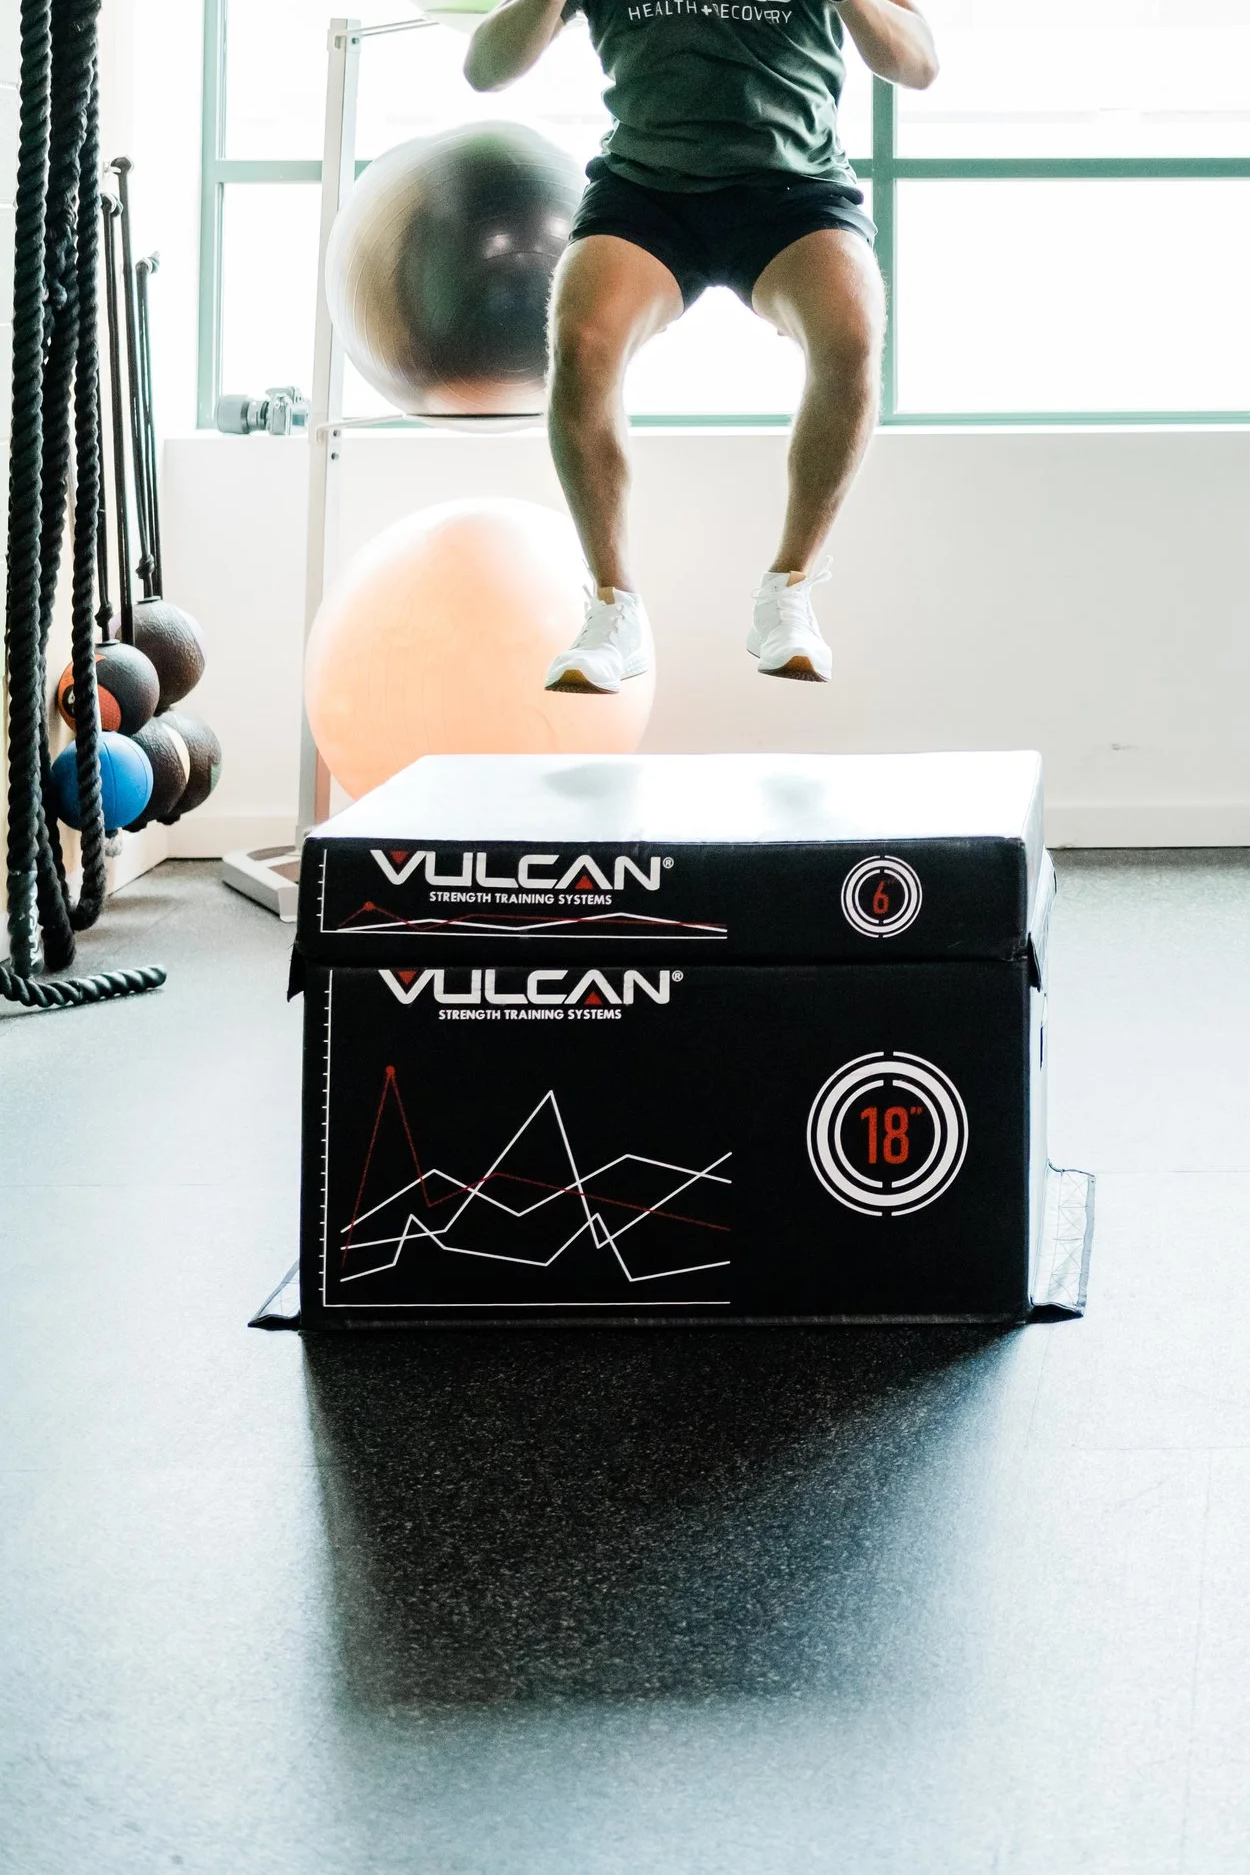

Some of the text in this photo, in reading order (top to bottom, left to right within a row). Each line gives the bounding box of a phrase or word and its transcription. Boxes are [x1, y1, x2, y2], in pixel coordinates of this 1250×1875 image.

[429, 891, 612, 906] STRENGTH TRAINING SYSTEMS
[438, 1009, 622, 1020] STRENGTH TRAINING SYSTEMS
